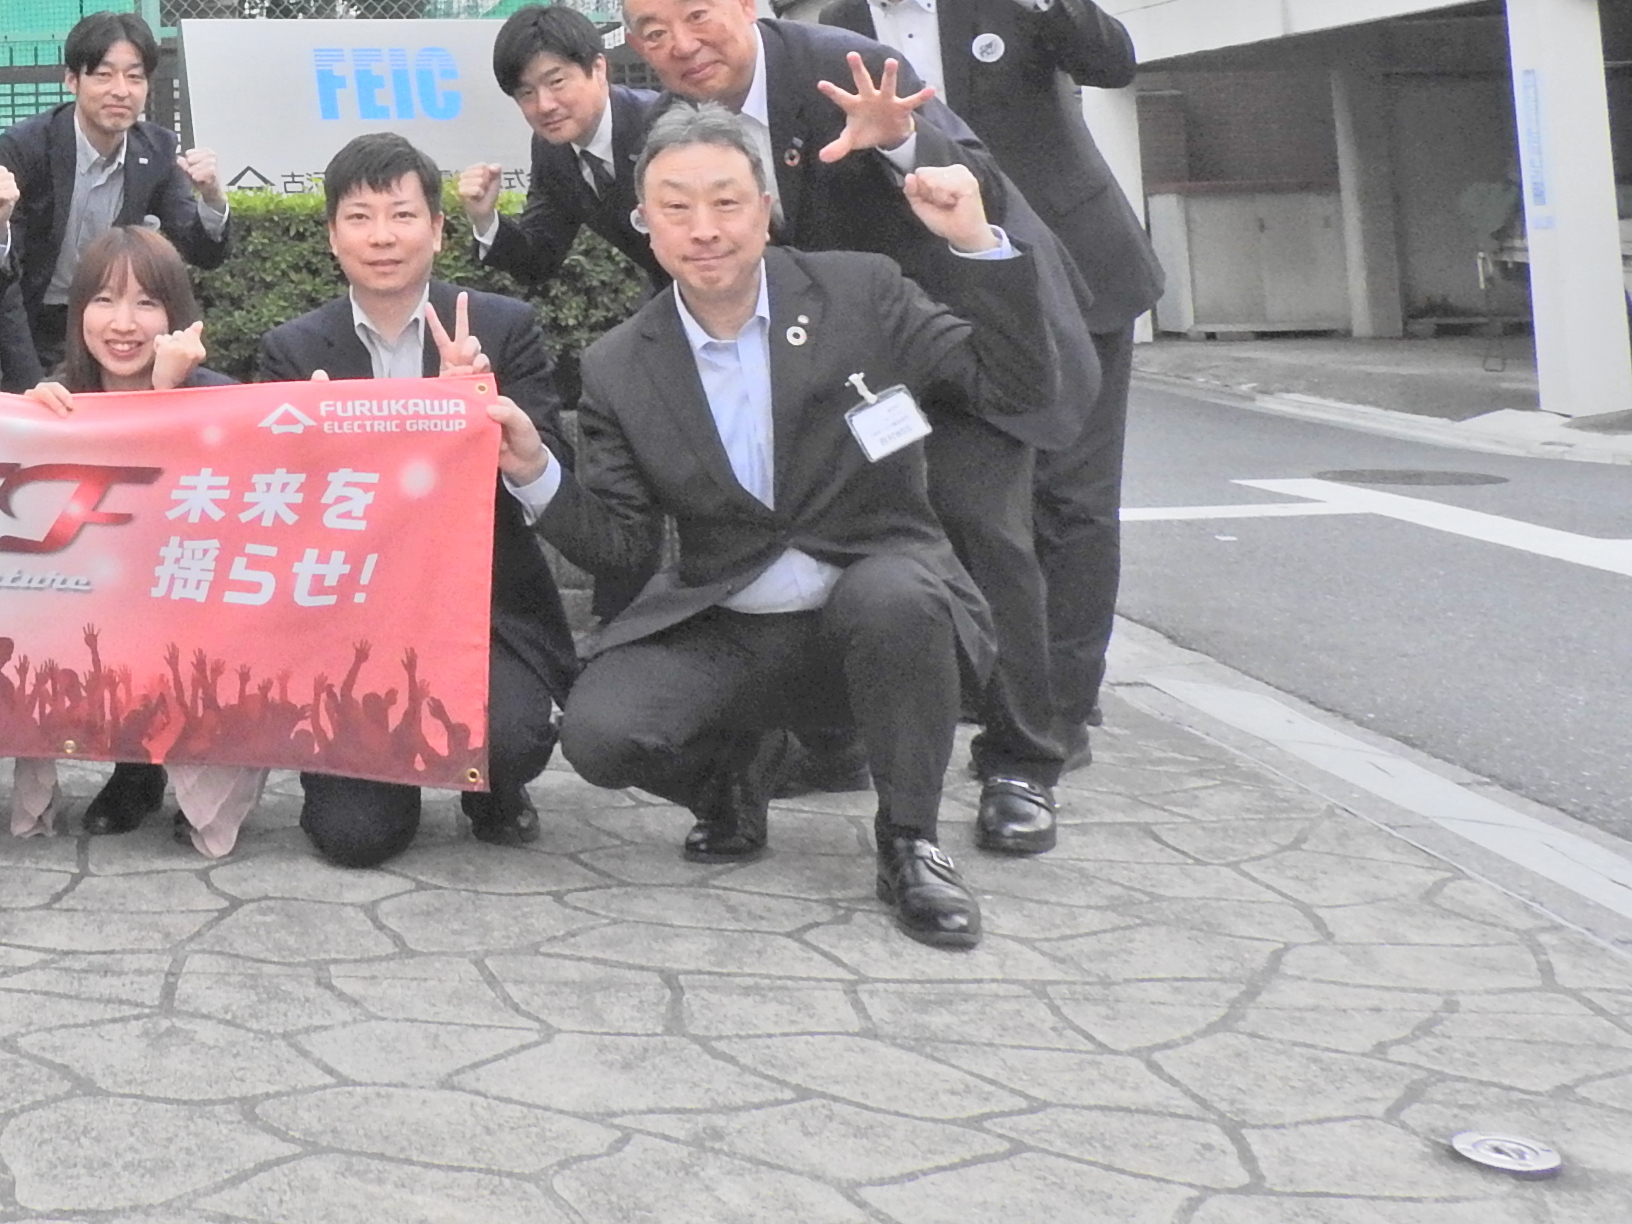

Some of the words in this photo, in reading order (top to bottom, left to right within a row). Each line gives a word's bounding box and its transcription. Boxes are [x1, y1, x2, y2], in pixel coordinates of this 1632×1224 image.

[313, 47, 463, 121] FEIC
[319, 398, 467, 417] FURUKAWA
[323, 419, 400, 434] ELECTRIC
[405, 418, 467, 433] GROUP
[164, 467, 380, 531] 未来を
[150, 536, 379, 607] 揺らせ!
